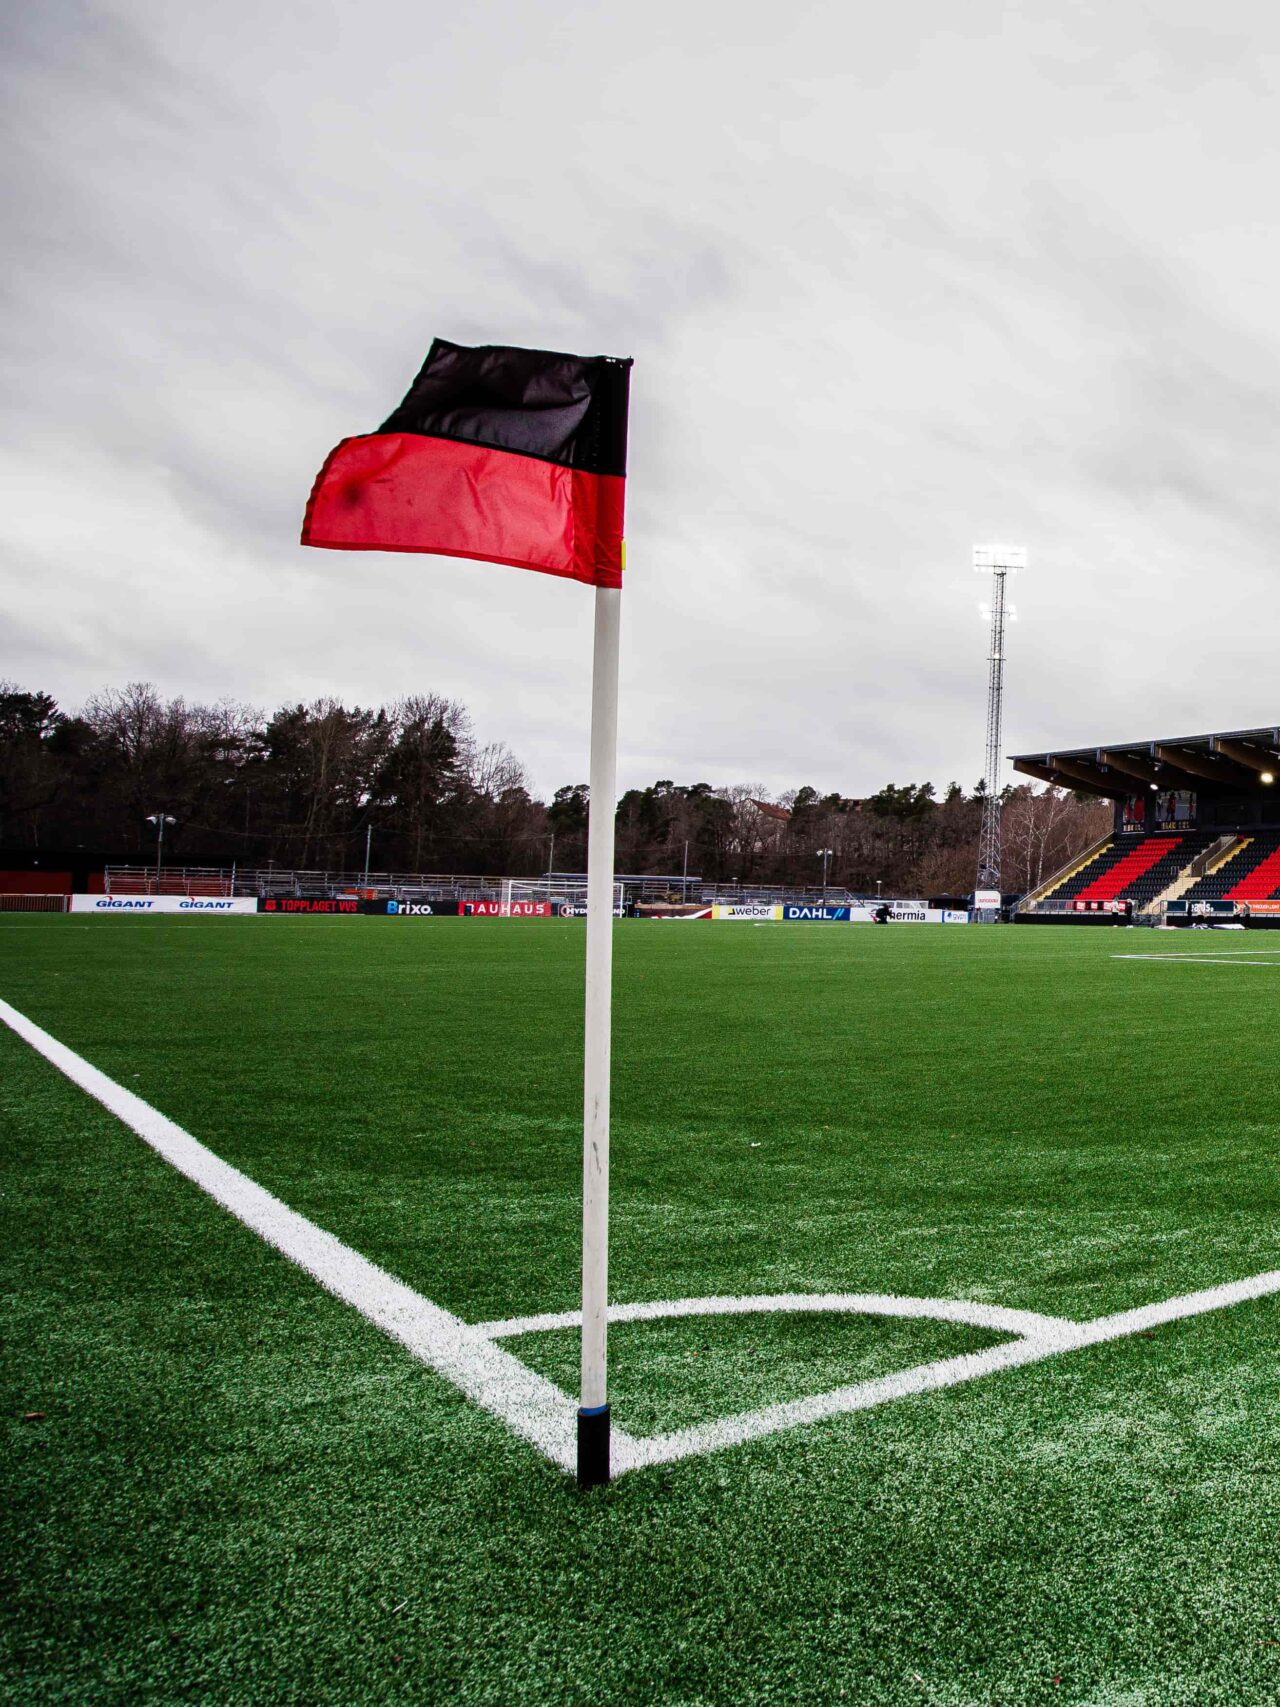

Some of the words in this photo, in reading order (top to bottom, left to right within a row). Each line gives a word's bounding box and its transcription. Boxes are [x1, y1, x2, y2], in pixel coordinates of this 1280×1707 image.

[96, 899, 154, 908] GIGANT
[179, 899, 233, 909] GIGANT
[281, 900, 337, 912] TOPPLAGET
[338, 901, 358, 912] VVS
[387, 900, 433, 915] Brixo.
[736, 905, 771, 916] weber
[789, 907, 832, 919] DAHL
[889, 909, 926, 921] hermia
